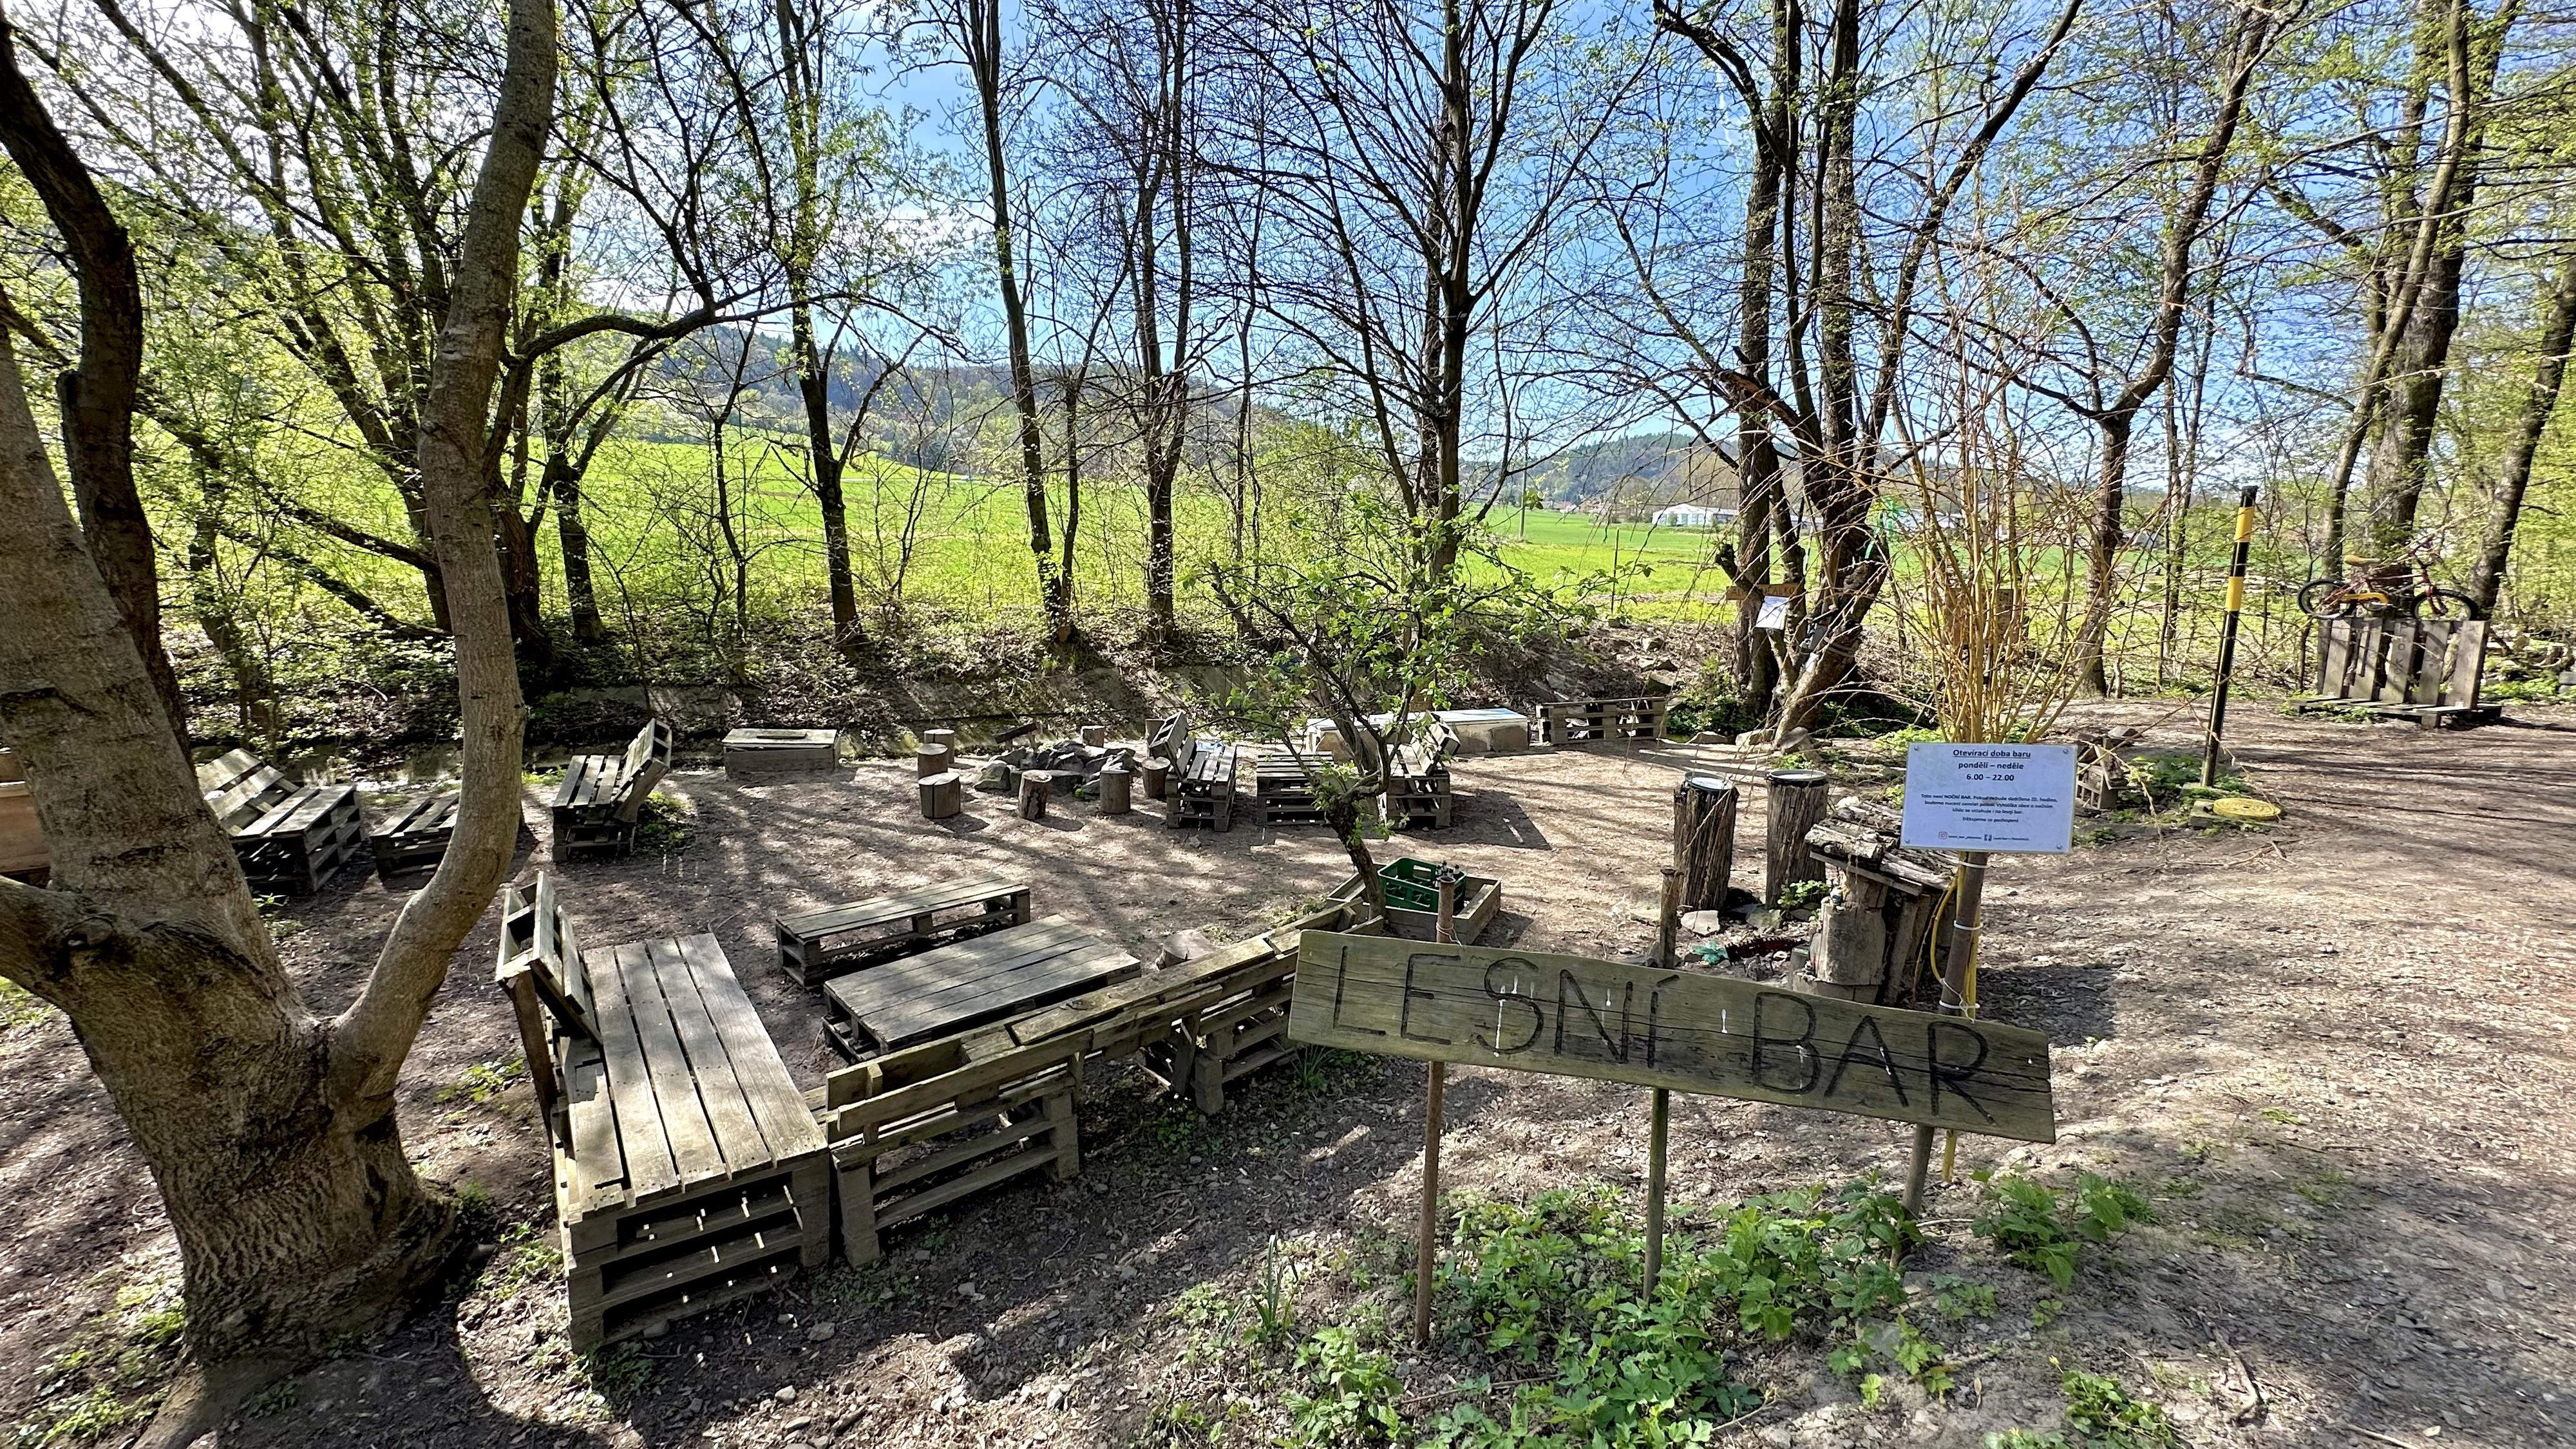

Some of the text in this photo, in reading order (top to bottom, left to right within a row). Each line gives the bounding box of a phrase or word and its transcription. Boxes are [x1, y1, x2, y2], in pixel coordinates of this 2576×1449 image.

[1958, 761, 1988, 770] pondělí
[1332, 945, 1997, 1124] LESNÍ BAR
